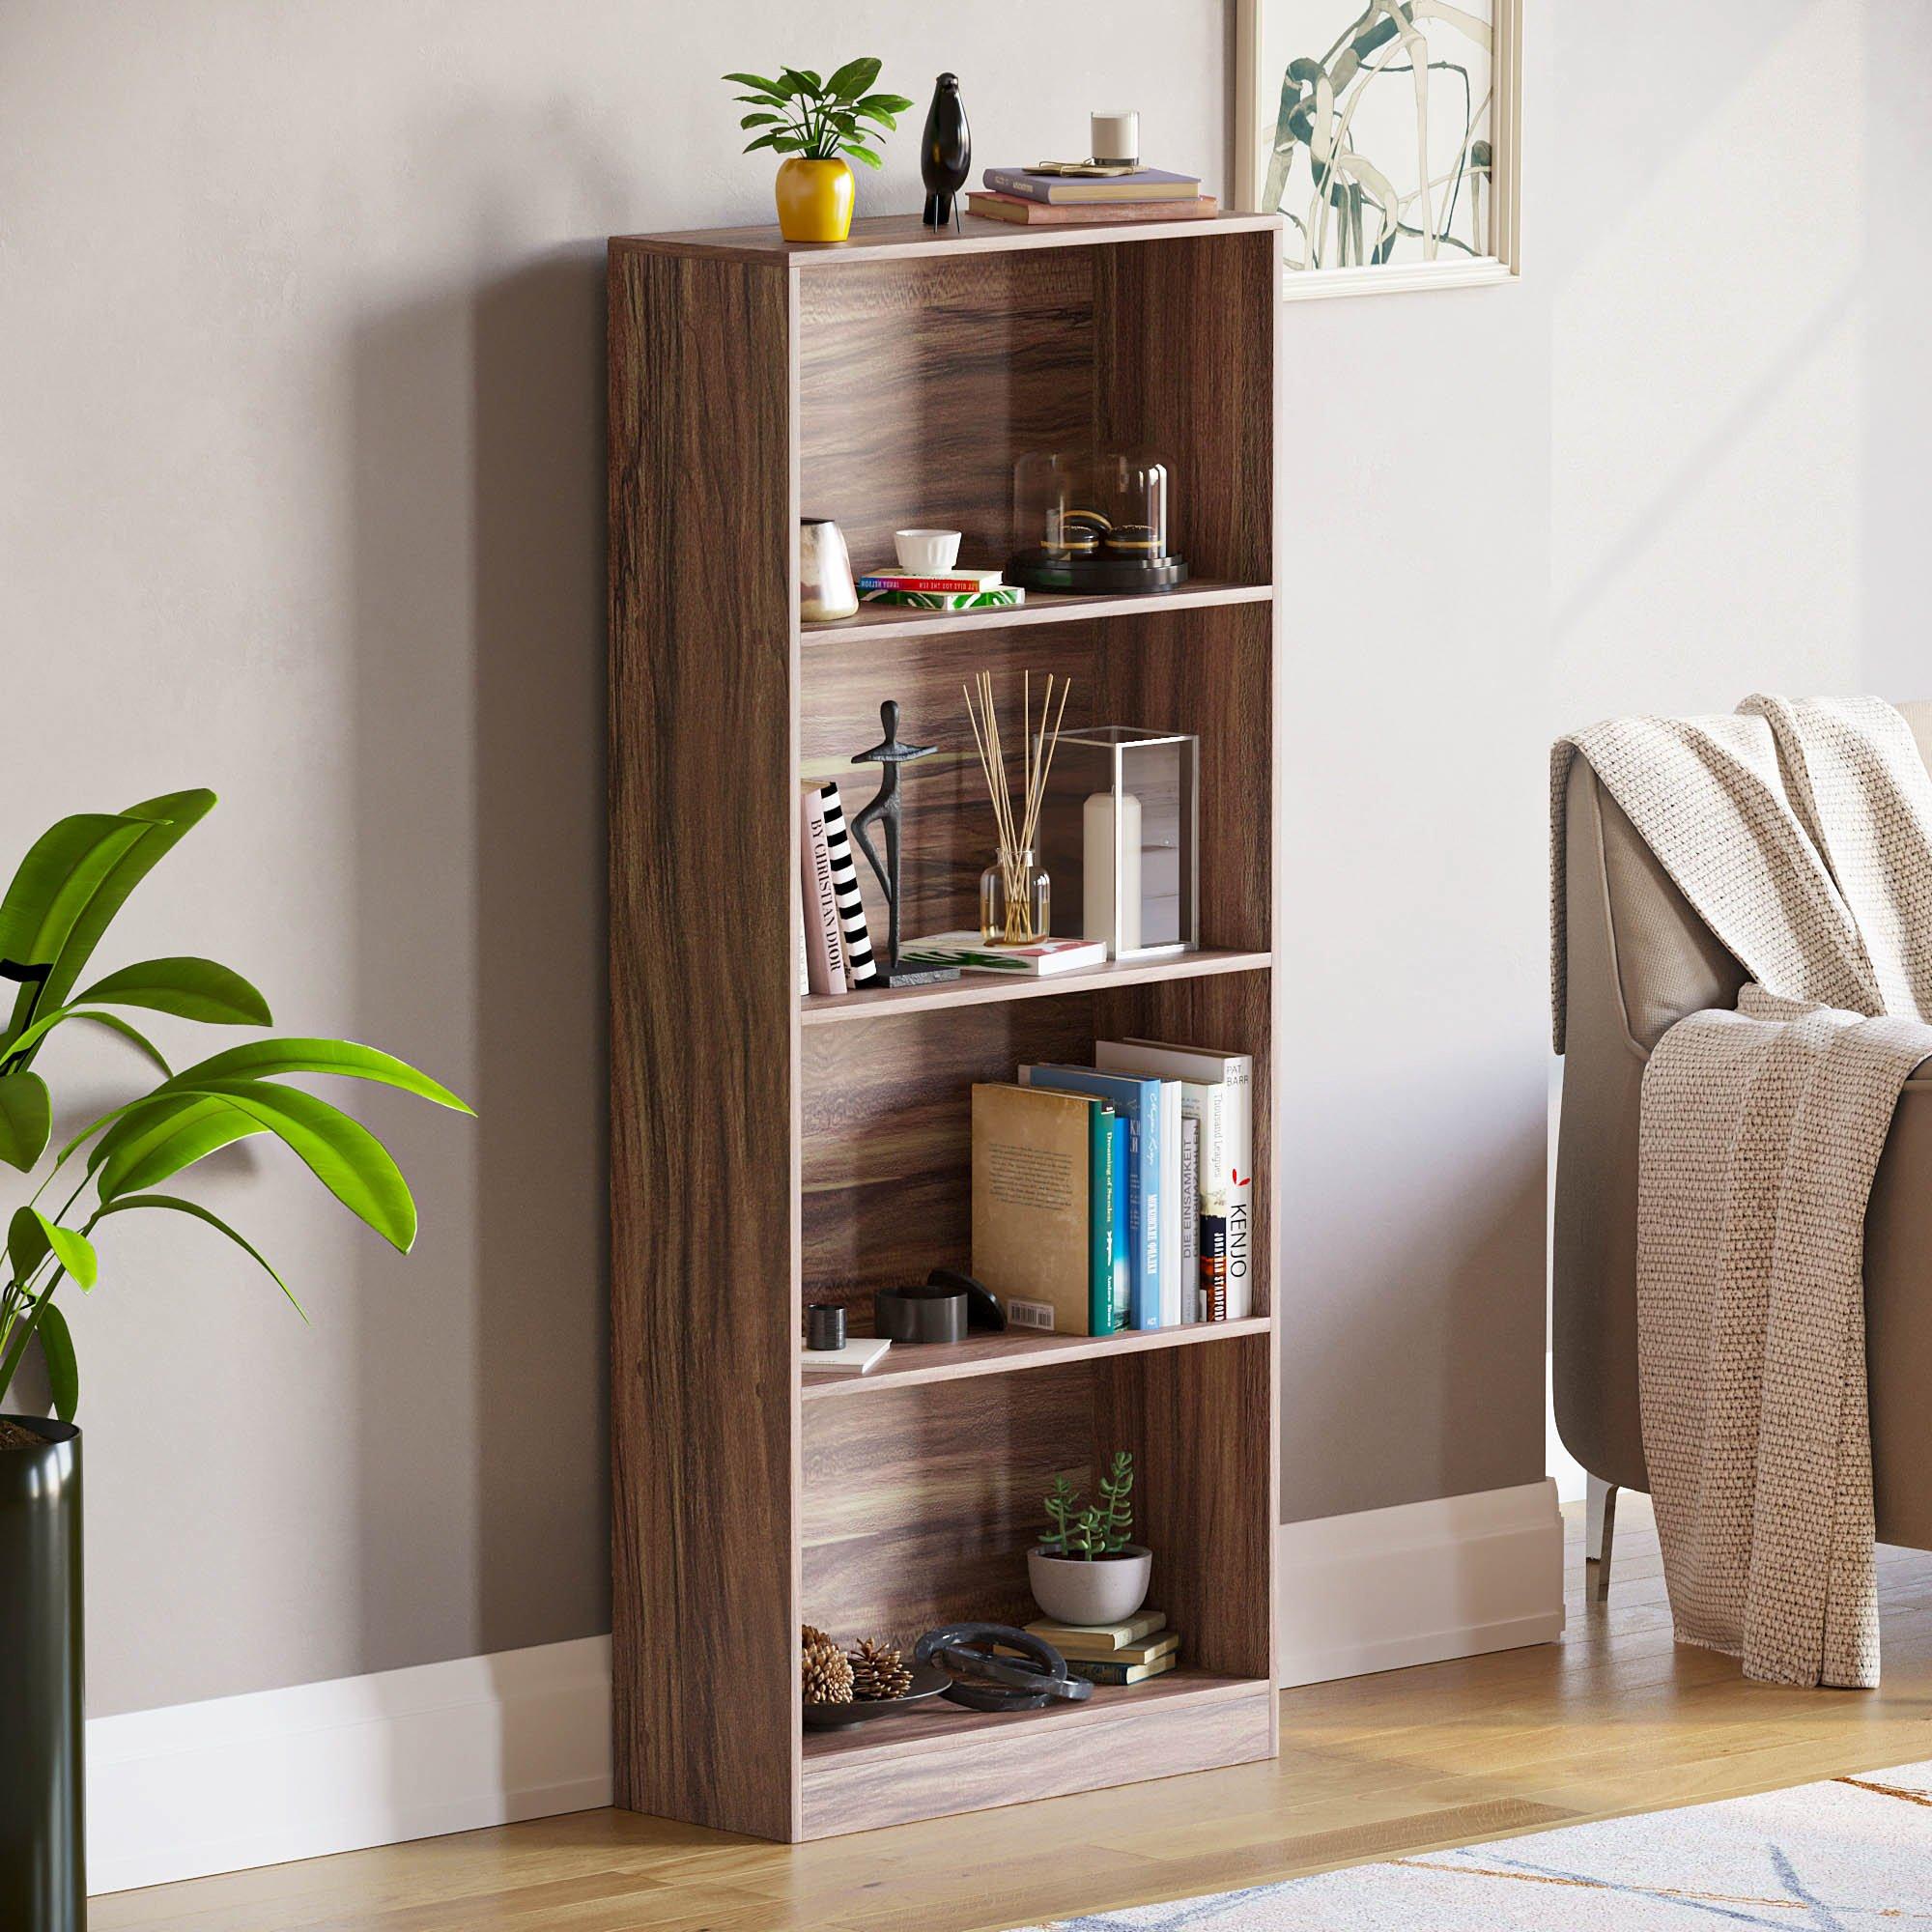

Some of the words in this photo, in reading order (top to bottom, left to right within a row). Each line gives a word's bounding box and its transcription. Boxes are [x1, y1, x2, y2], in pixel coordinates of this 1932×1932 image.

[811, 819, 823, 838] BY
[814, 842, 837, 927] CHRISTIAN
[826, 931, 841, 973] DIOR
[1226, 1065, 1241, 1075] PAT
[1213, 1093, 1223, 1139] Thousand
[1211, 1140, 1223, 1178] Leagues
[1183, 1139, 1192, 1230] EINSAMKEIT
[1213, 1233, 1224, 1273] JONATHAN
[1230, 1204, 1247, 1278] KENJO
[1213, 1276, 1225, 1321] STANDFORD
